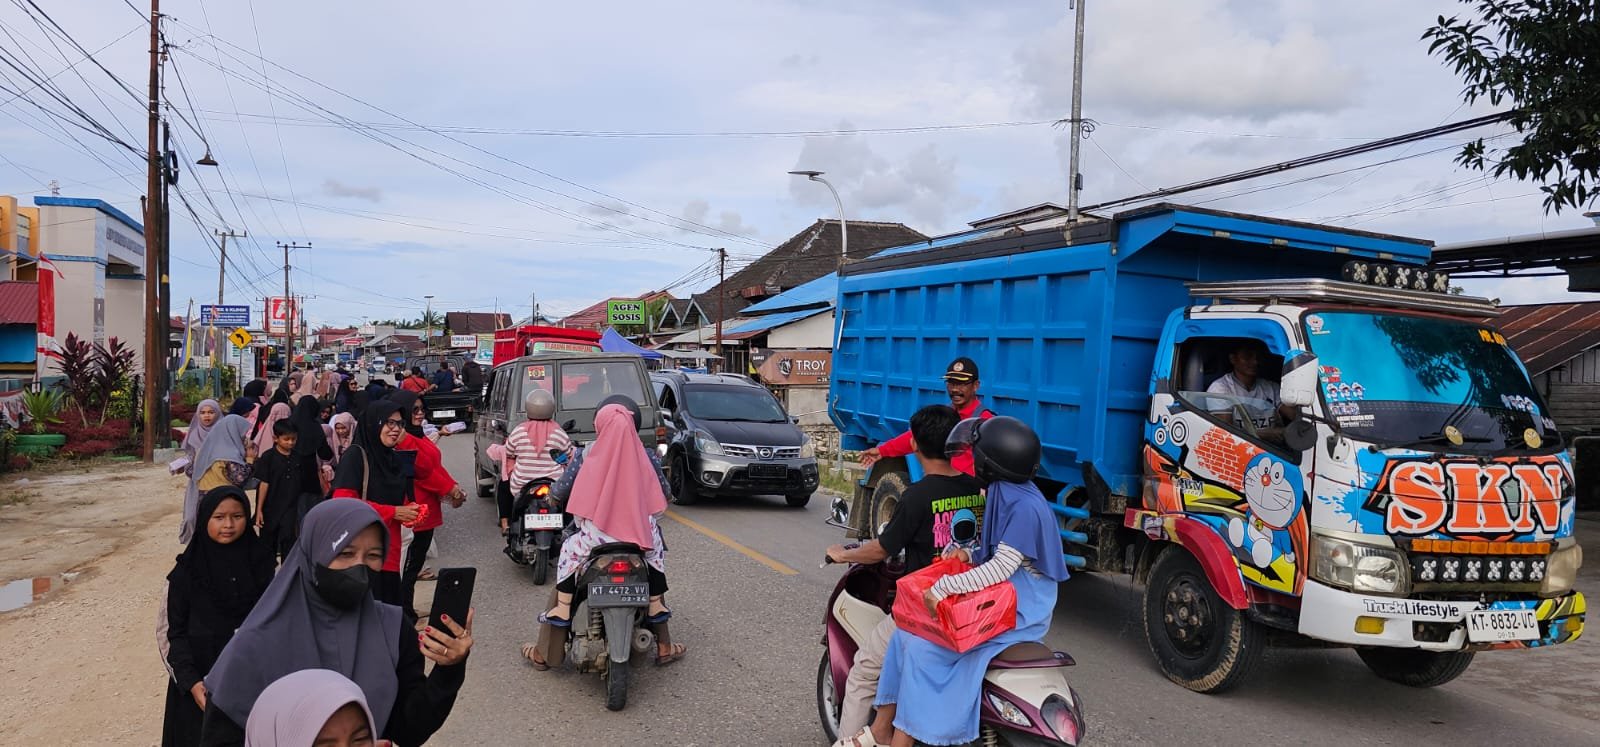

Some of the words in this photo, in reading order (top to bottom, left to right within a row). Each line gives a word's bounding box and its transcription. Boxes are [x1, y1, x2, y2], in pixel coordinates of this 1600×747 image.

[795, 360, 826, 371] TROY
[1387, 461, 1563, 535] SKN
[592, 586, 603, 595] KT
[608, 586, 630, 594] 4472
[634, 585, 645, 594] VV
[1490, 613, 1518, 630] 8832
